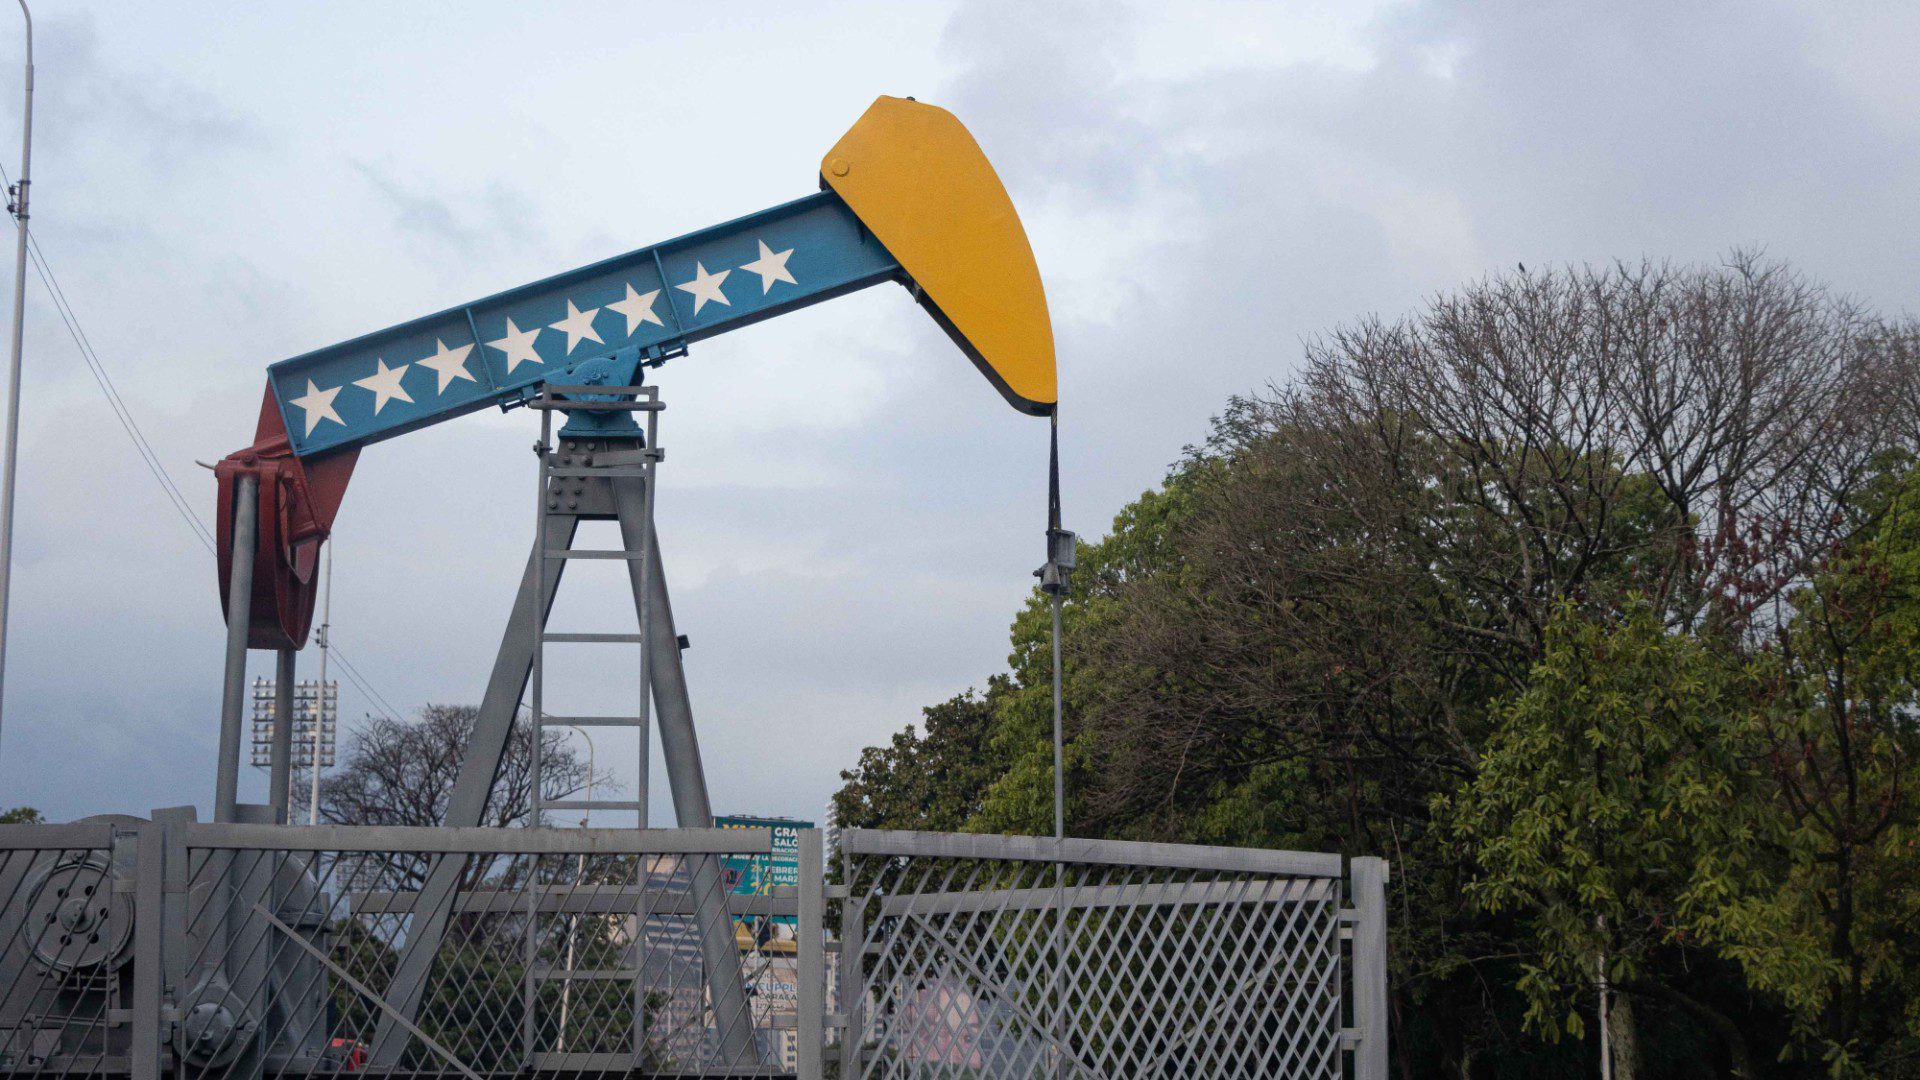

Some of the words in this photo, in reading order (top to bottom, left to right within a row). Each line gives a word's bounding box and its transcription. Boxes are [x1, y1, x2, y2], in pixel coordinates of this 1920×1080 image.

[775, 827, 798, 837] GRA
[774, 837, 798, 847] SALÓ
[763, 866, 798, 875] FEBRER
[759, 992, 797, 1001] CARACA
